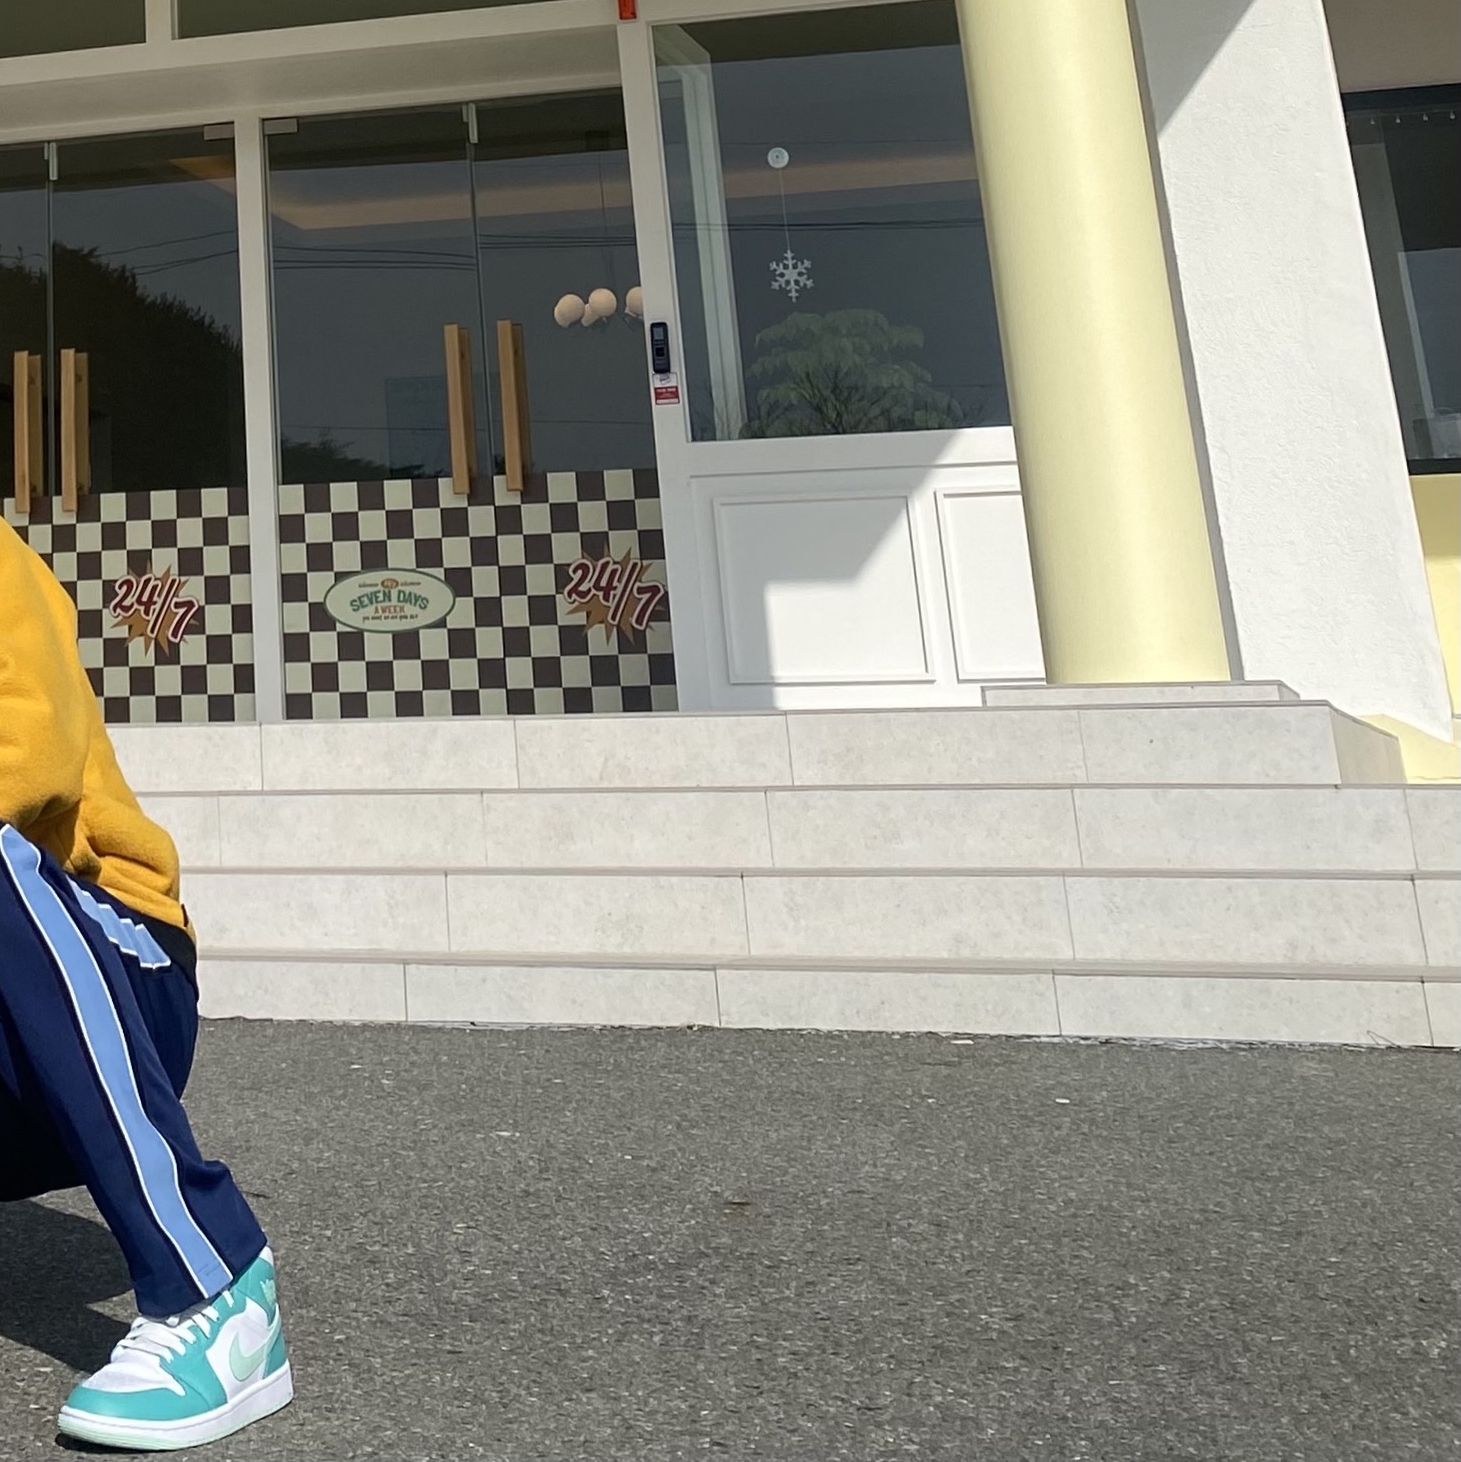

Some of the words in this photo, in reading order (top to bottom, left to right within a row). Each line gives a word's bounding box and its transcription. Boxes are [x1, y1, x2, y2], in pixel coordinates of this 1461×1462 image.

[111, 575, 197, 642] 24/7
[350, 589, 392, 612] SEVEN
[397, 589, 429, 610] DAYS
[374, 606, 380, 615] A
[381, 605, 405, 614] WEEK
[565, 558, 664, 630] 24/7
